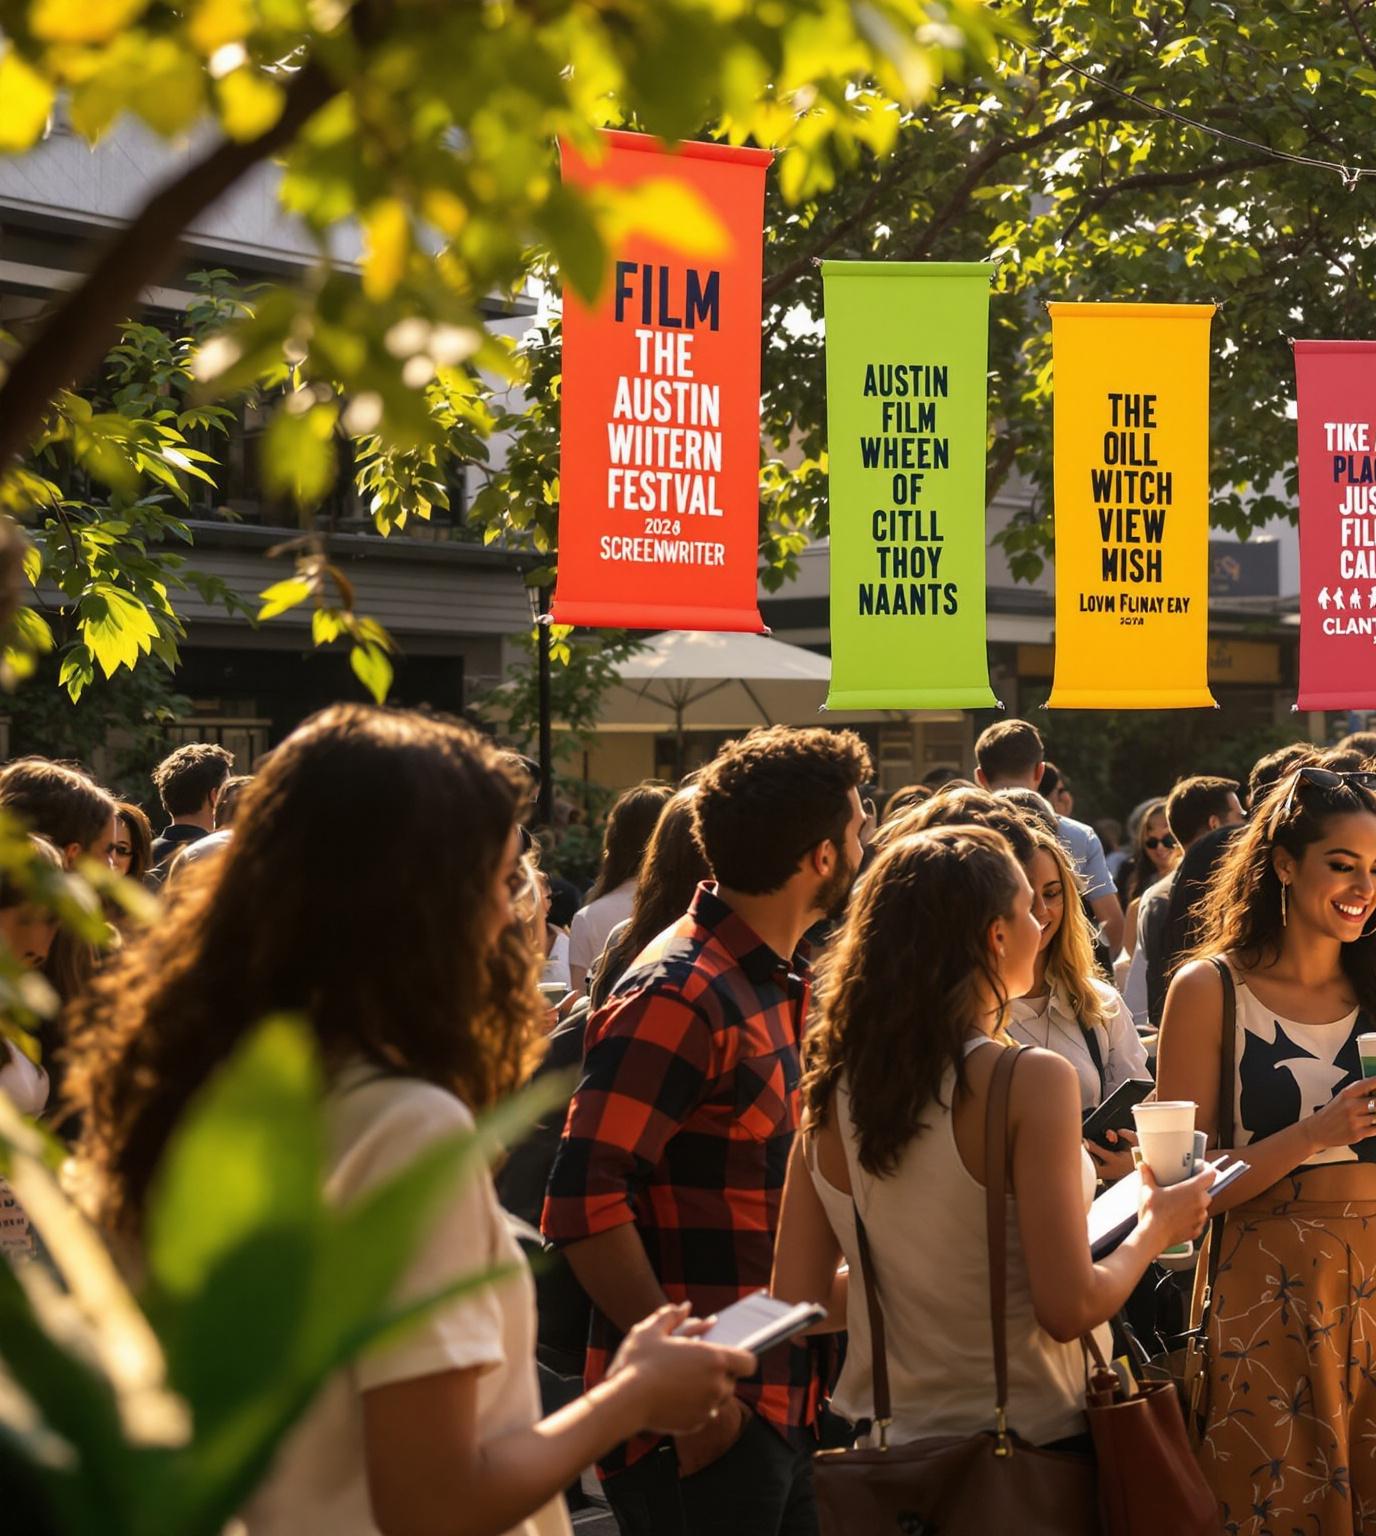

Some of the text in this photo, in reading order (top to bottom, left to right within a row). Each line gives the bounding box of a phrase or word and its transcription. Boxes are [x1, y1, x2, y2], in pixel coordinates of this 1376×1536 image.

[616, 261, 720, 331] FILM
[635, 330, 694, 378] THE
[864, 364, 948, 397] AUSTIN
[613, 376, 719, 427] AUSTIN
[882, 402, 936, 433] FILM
[1108, 393, 1157, 429] THE
[860, 438, 949, 469] WHEEN
[1104, 432, 1157, 466] OILL
[1324, 423, 1369, 452] TIKE
[608, 469, 723, 516] FESTVAL
[893, 474, 922, 505] OF
[1092, 470, 1172, 505] WITCH
[872, 510, 944, 542] CITLL
[1098, 509, 1166, 543] VIEW
[600, 536, 725, 566] SCREENWRITER
[877, 547, 942, 578] THOY
[859, 583, 958, 616] NAANTS
